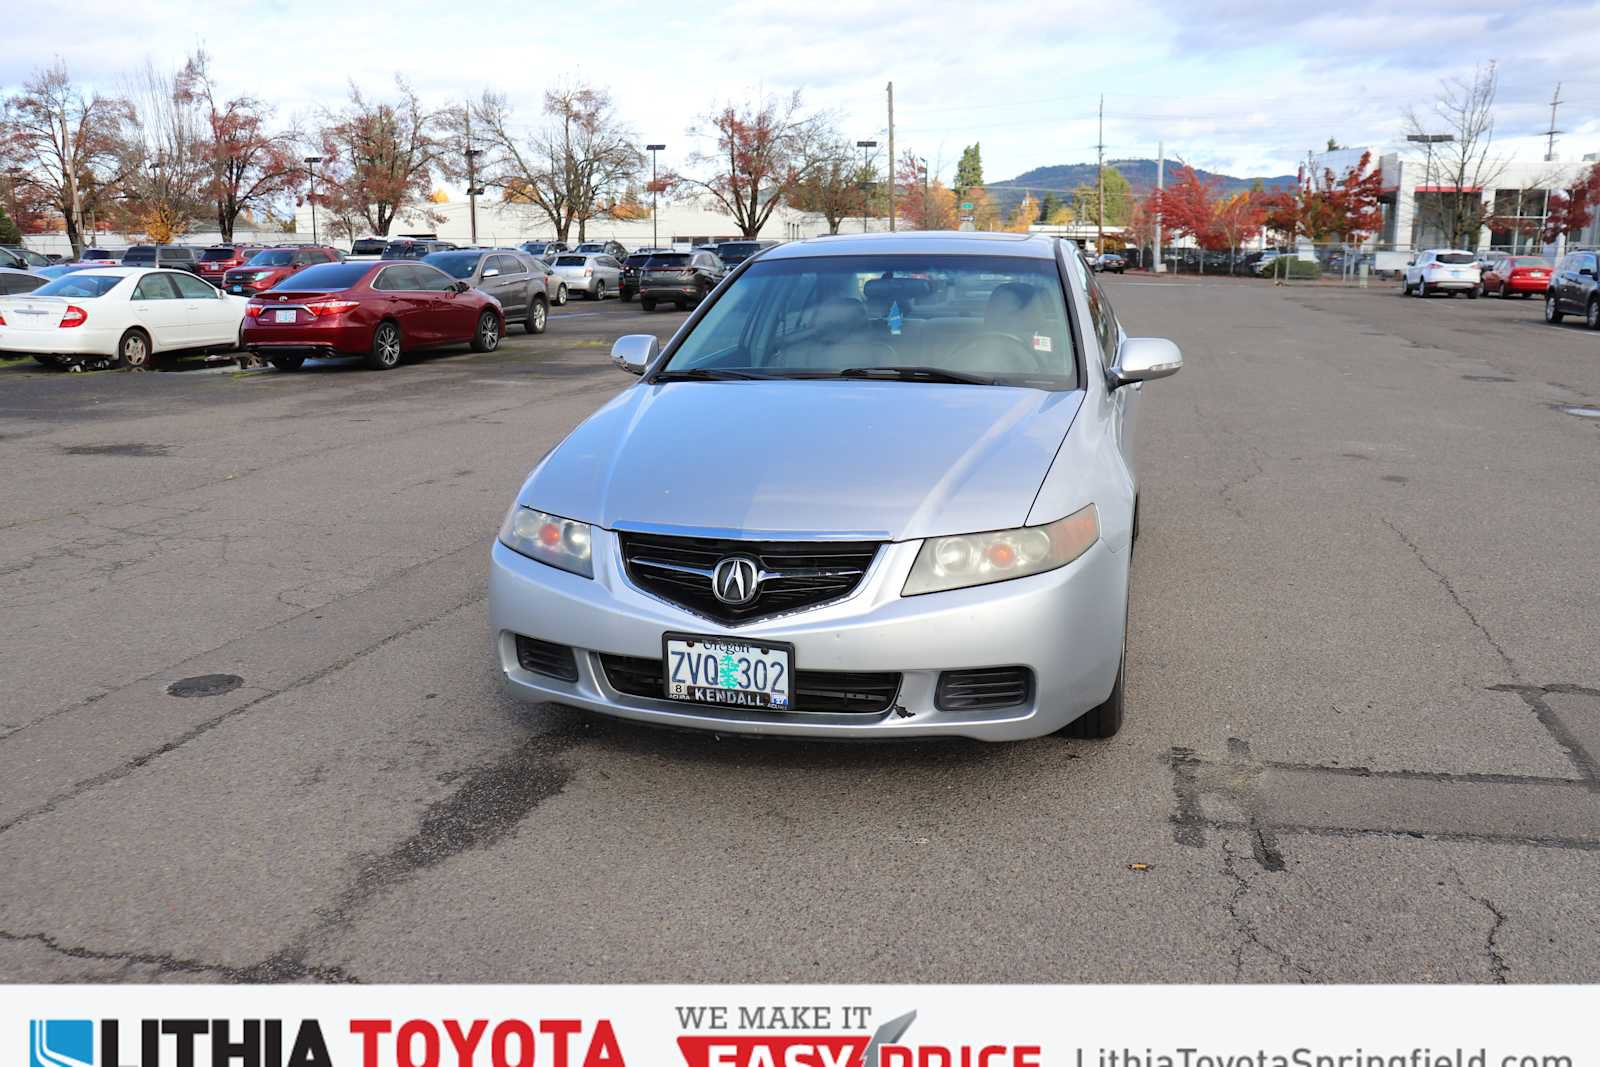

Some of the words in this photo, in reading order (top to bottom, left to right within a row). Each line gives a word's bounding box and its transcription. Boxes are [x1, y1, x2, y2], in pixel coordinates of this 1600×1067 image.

[671, 650, 718, 686] ZVQ
[737, 657, 785, 693] 302
[694, 688, 765, 706] KENDALL
